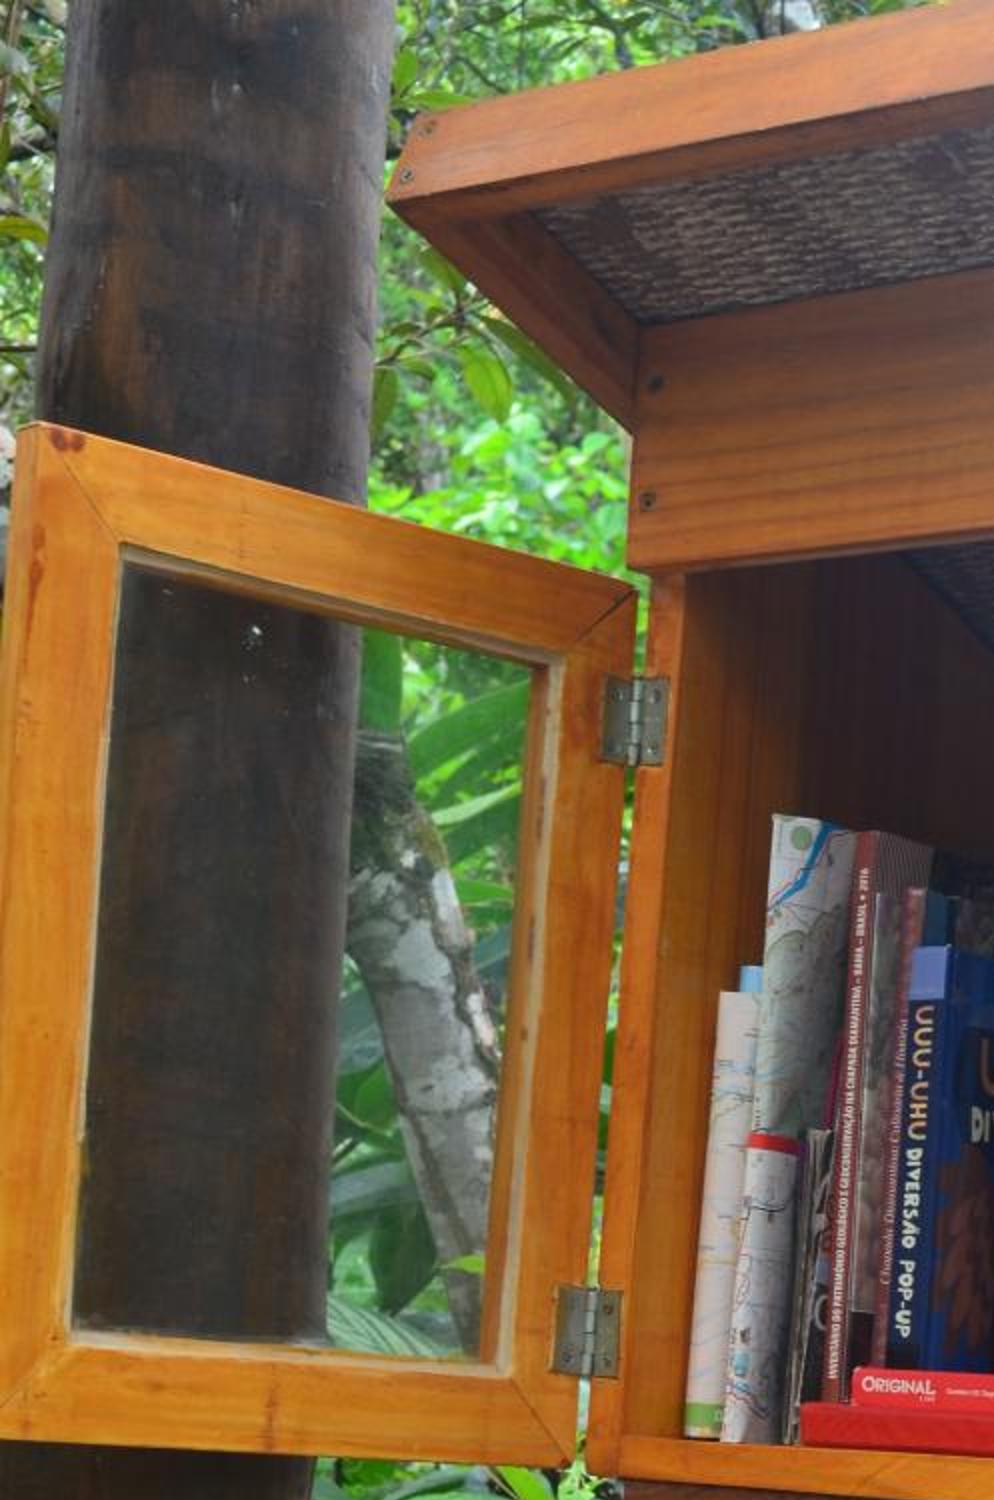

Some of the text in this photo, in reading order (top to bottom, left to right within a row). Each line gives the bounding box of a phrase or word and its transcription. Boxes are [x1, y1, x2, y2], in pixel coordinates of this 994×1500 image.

[896, 1004, 934, 1337] UUU-UHU DIVERSÃO POP-UP
[861, 1375, 935, 1394] ORIGINAL
